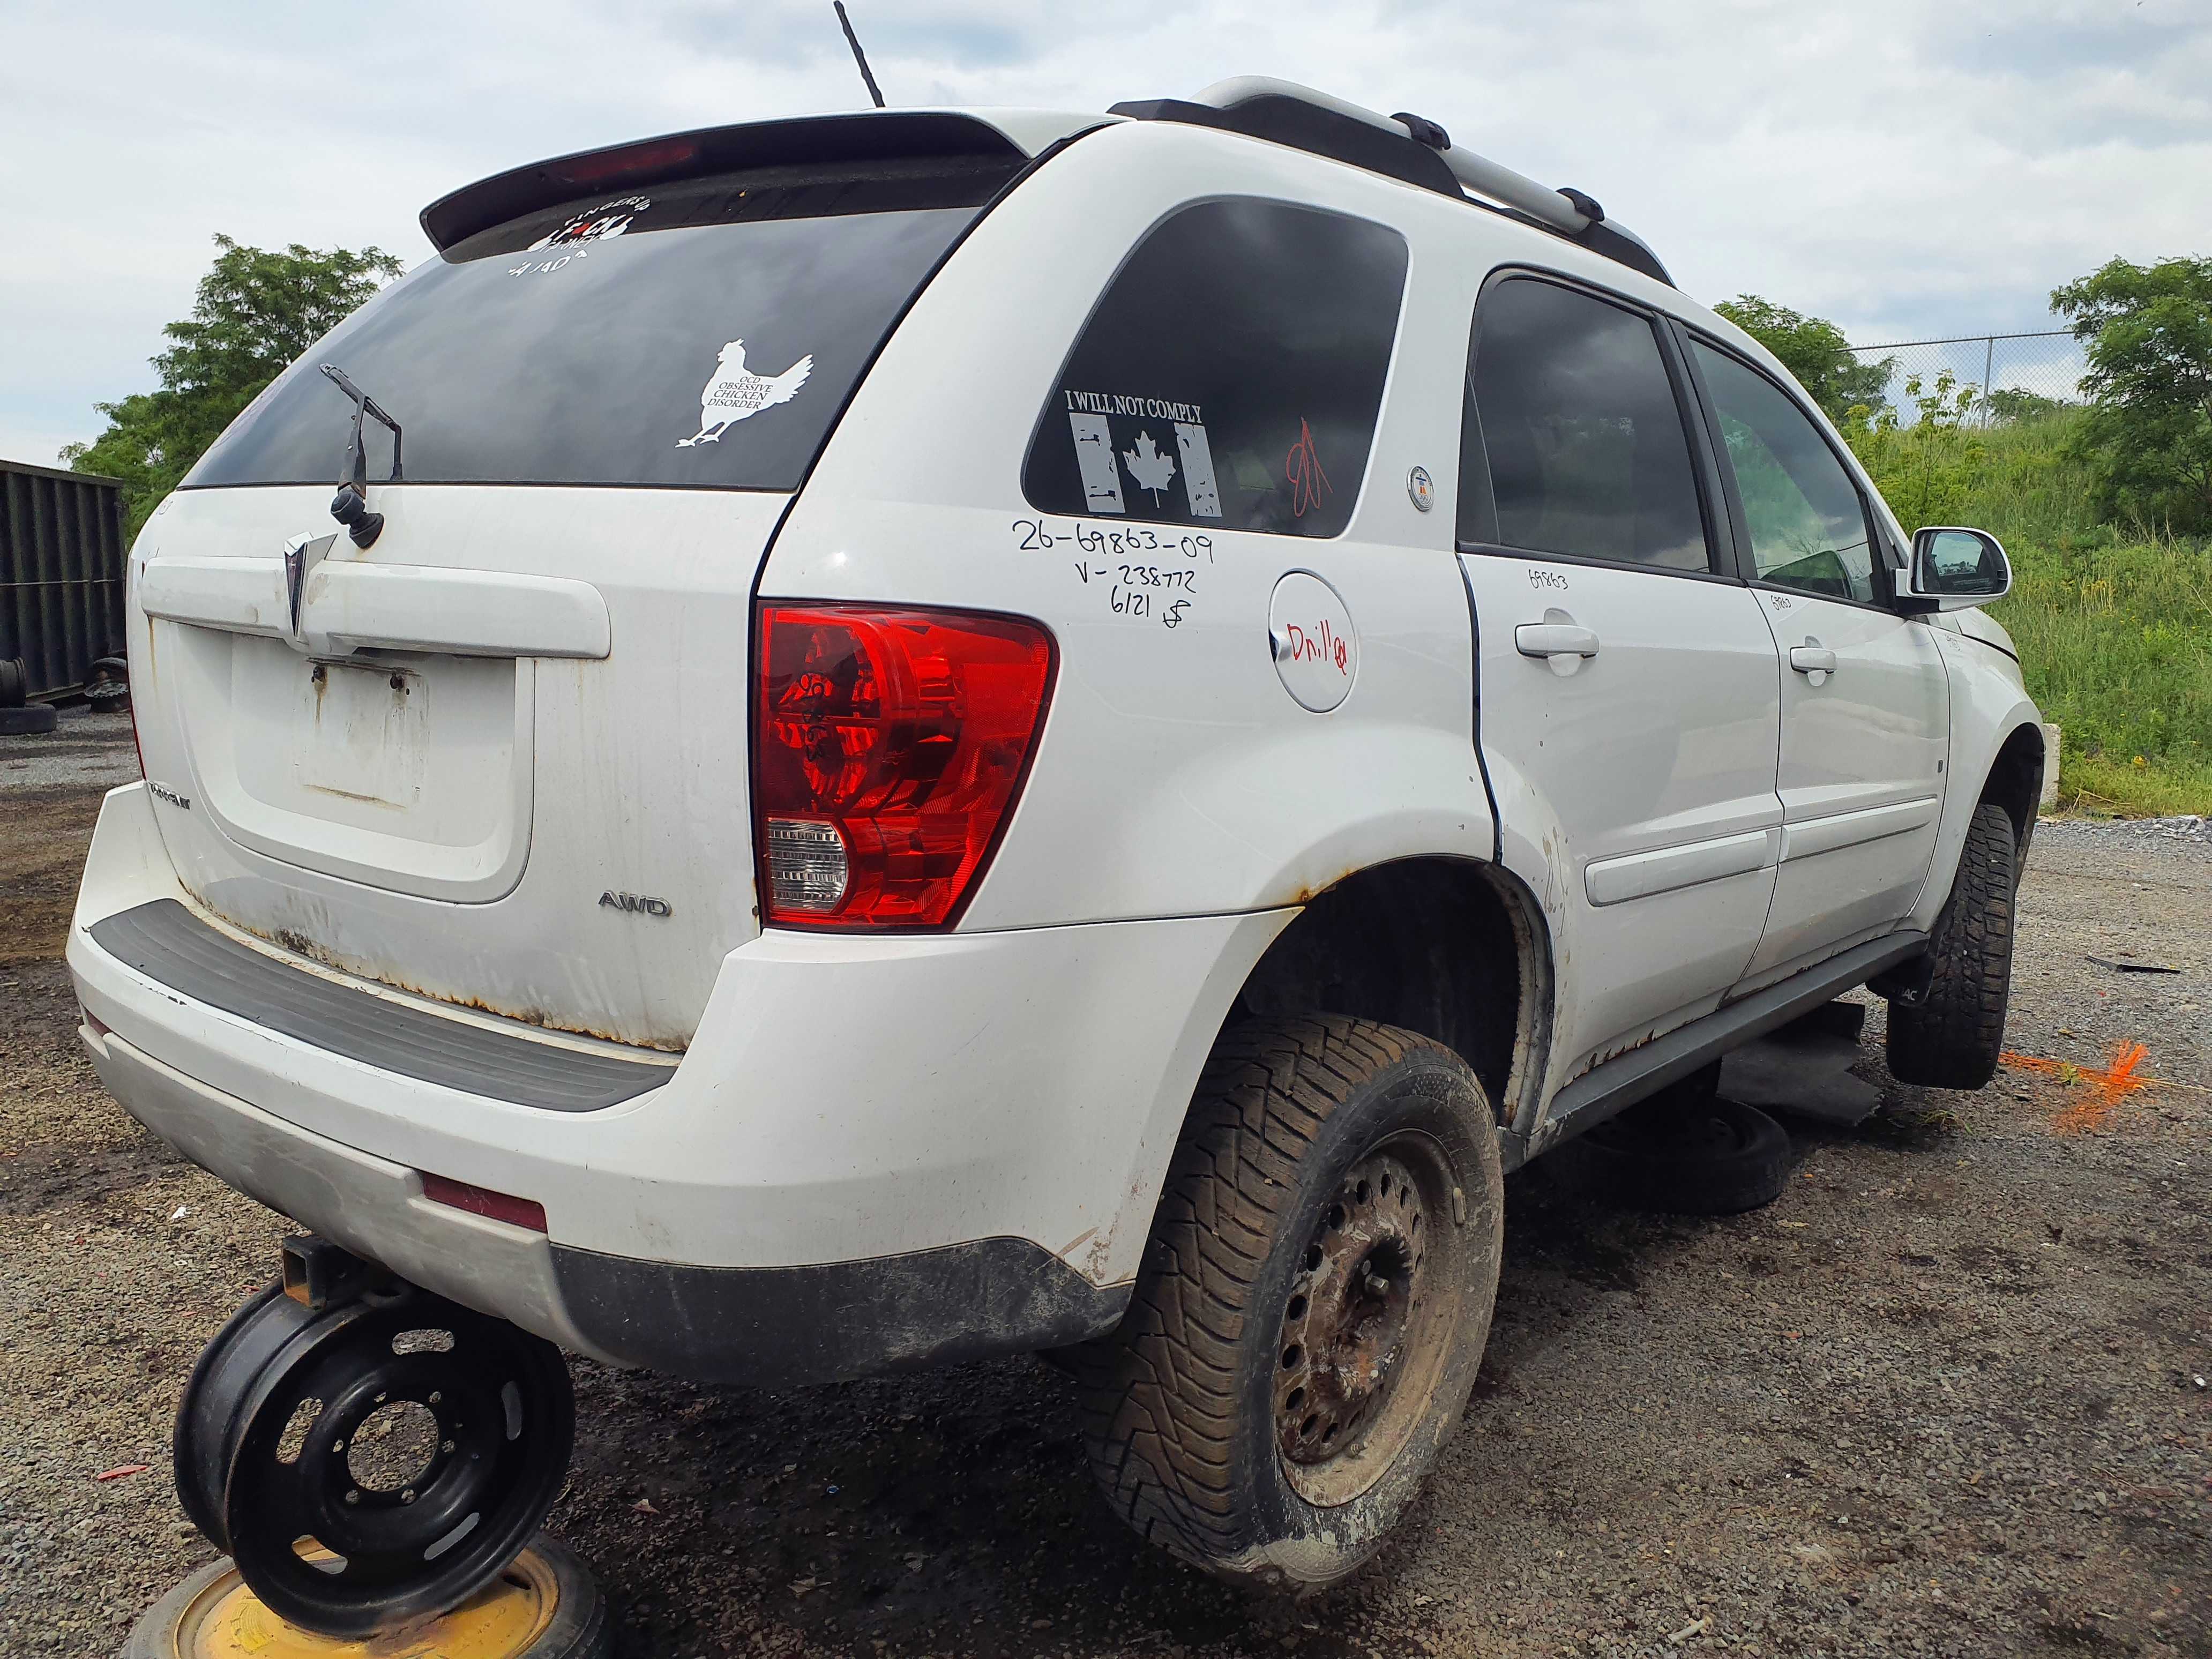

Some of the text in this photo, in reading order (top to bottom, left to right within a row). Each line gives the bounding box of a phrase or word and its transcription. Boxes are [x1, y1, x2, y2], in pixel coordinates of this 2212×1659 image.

[713, 390, 768, 401] CHICKEN
[719, 382, 773, 393] OBSESSIVE
[707, 398, 761, 409] DISORDER
[1064, 390, 1202, 424] I WILL NOT COMPLY
[1528, 569, 1568, 590] 69863
[598, 890, 672, 917] AWD
